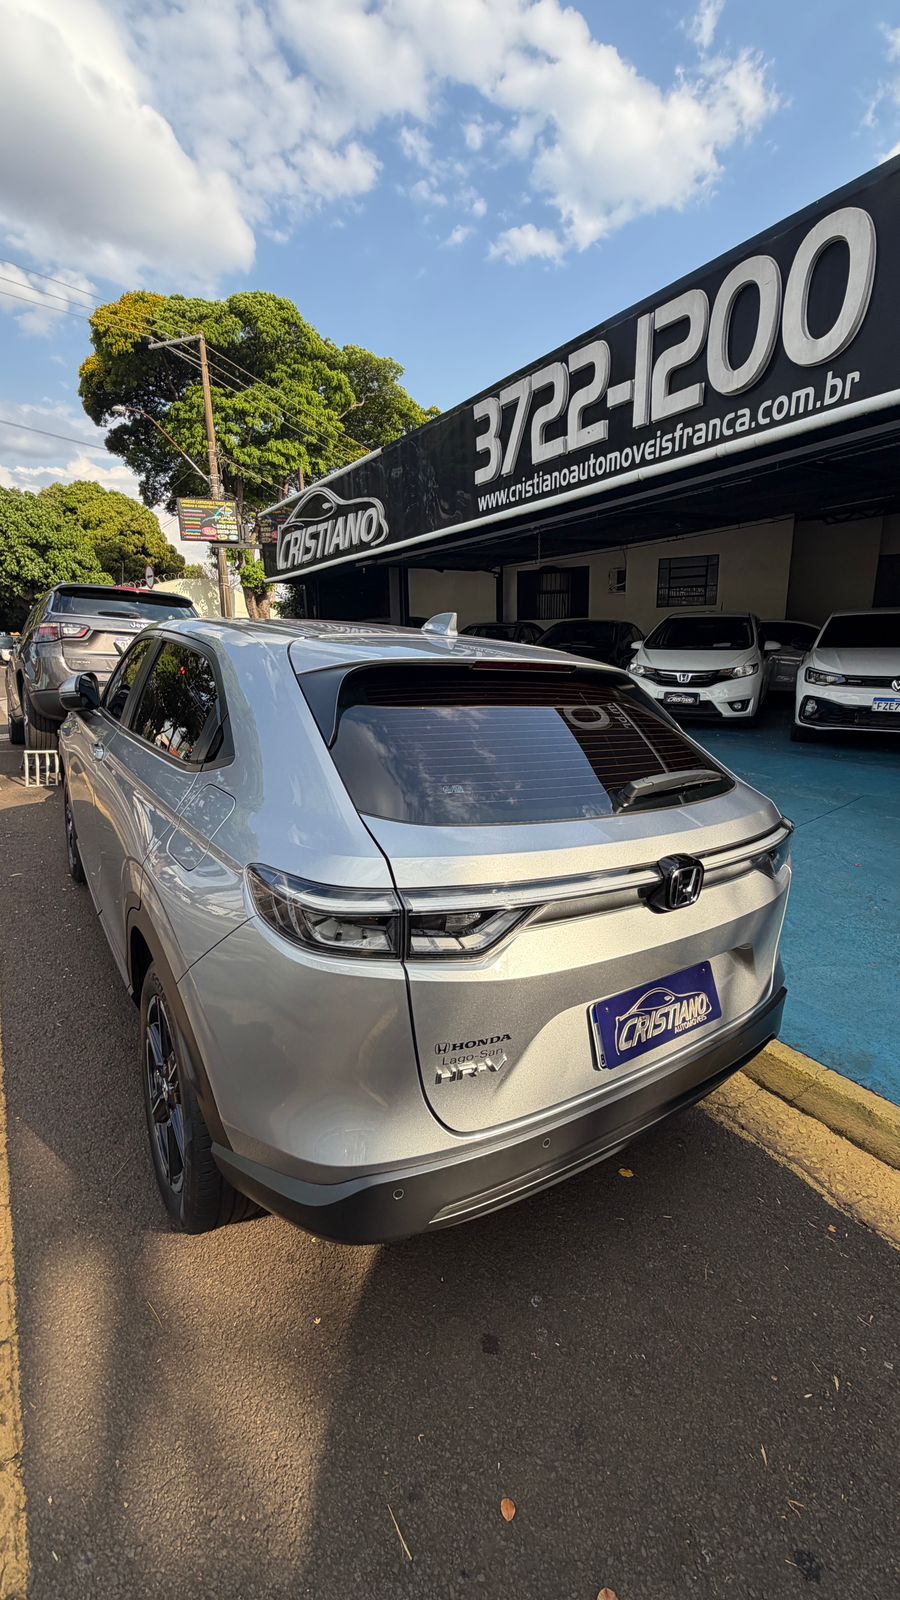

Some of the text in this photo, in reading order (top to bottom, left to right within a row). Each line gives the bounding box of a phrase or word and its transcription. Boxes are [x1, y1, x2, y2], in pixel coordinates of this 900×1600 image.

[474, 206, 877, 485] 3722-1200
[478, 371, 861, 513] www.cristianoautomoveisfranca.com.br
[279, 507, 379, 570] CRISTIANO
[451, 1034, 512, 1051] HONDA
[619, 993, 707, 1052] CRISTIANO
[435, 1053, 508, 1084] HR-V
[442, 1047, 503, 1066] Lago-San
